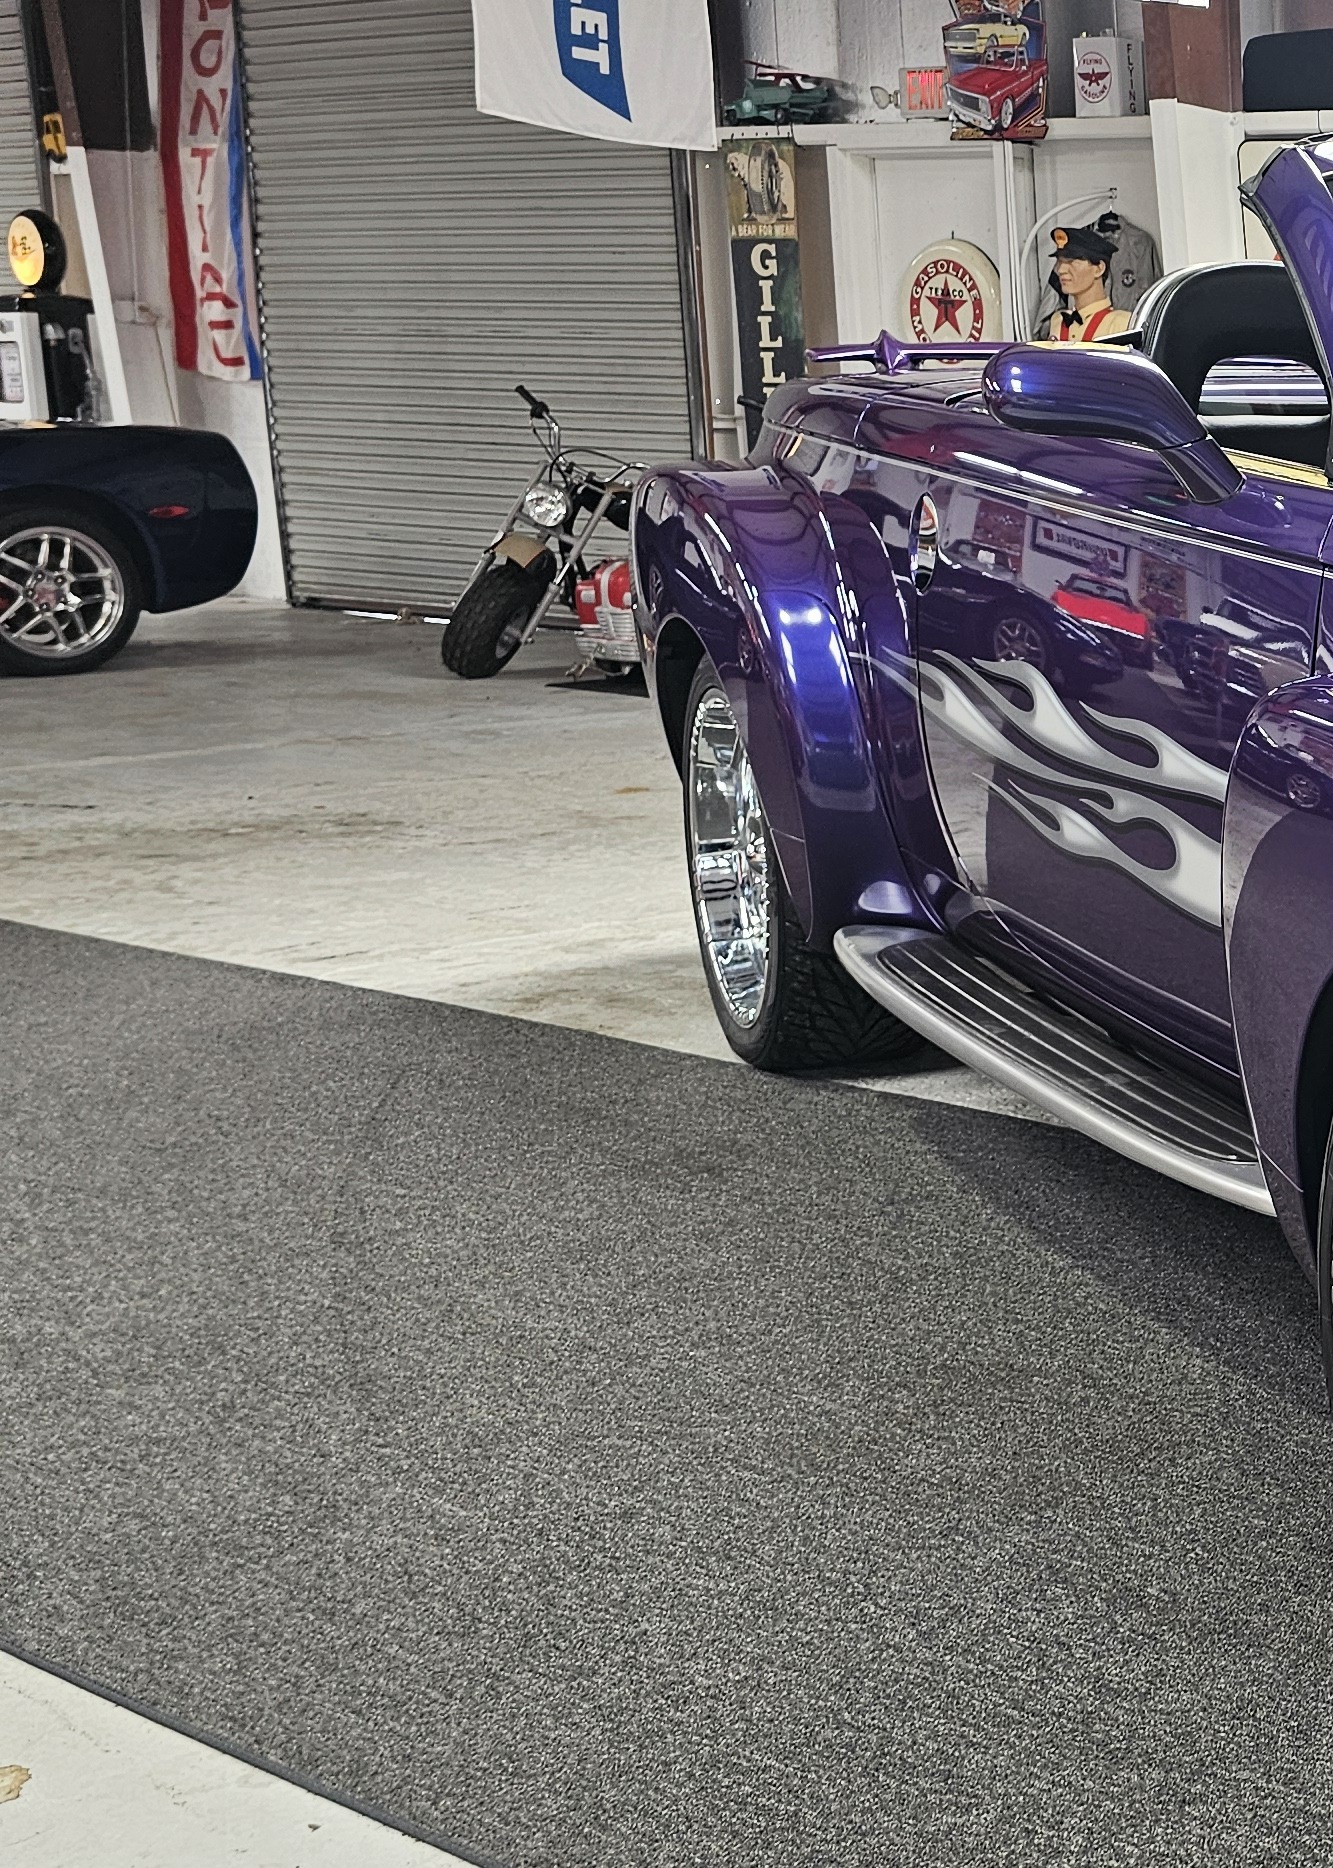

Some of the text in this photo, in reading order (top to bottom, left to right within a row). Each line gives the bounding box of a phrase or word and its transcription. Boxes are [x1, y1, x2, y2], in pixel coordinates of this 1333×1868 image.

[906, 69, 943, 111] EXIT
[1126, 43, 1136, 113] FLYING
[912, 260, 980, 301] GASOLINE
